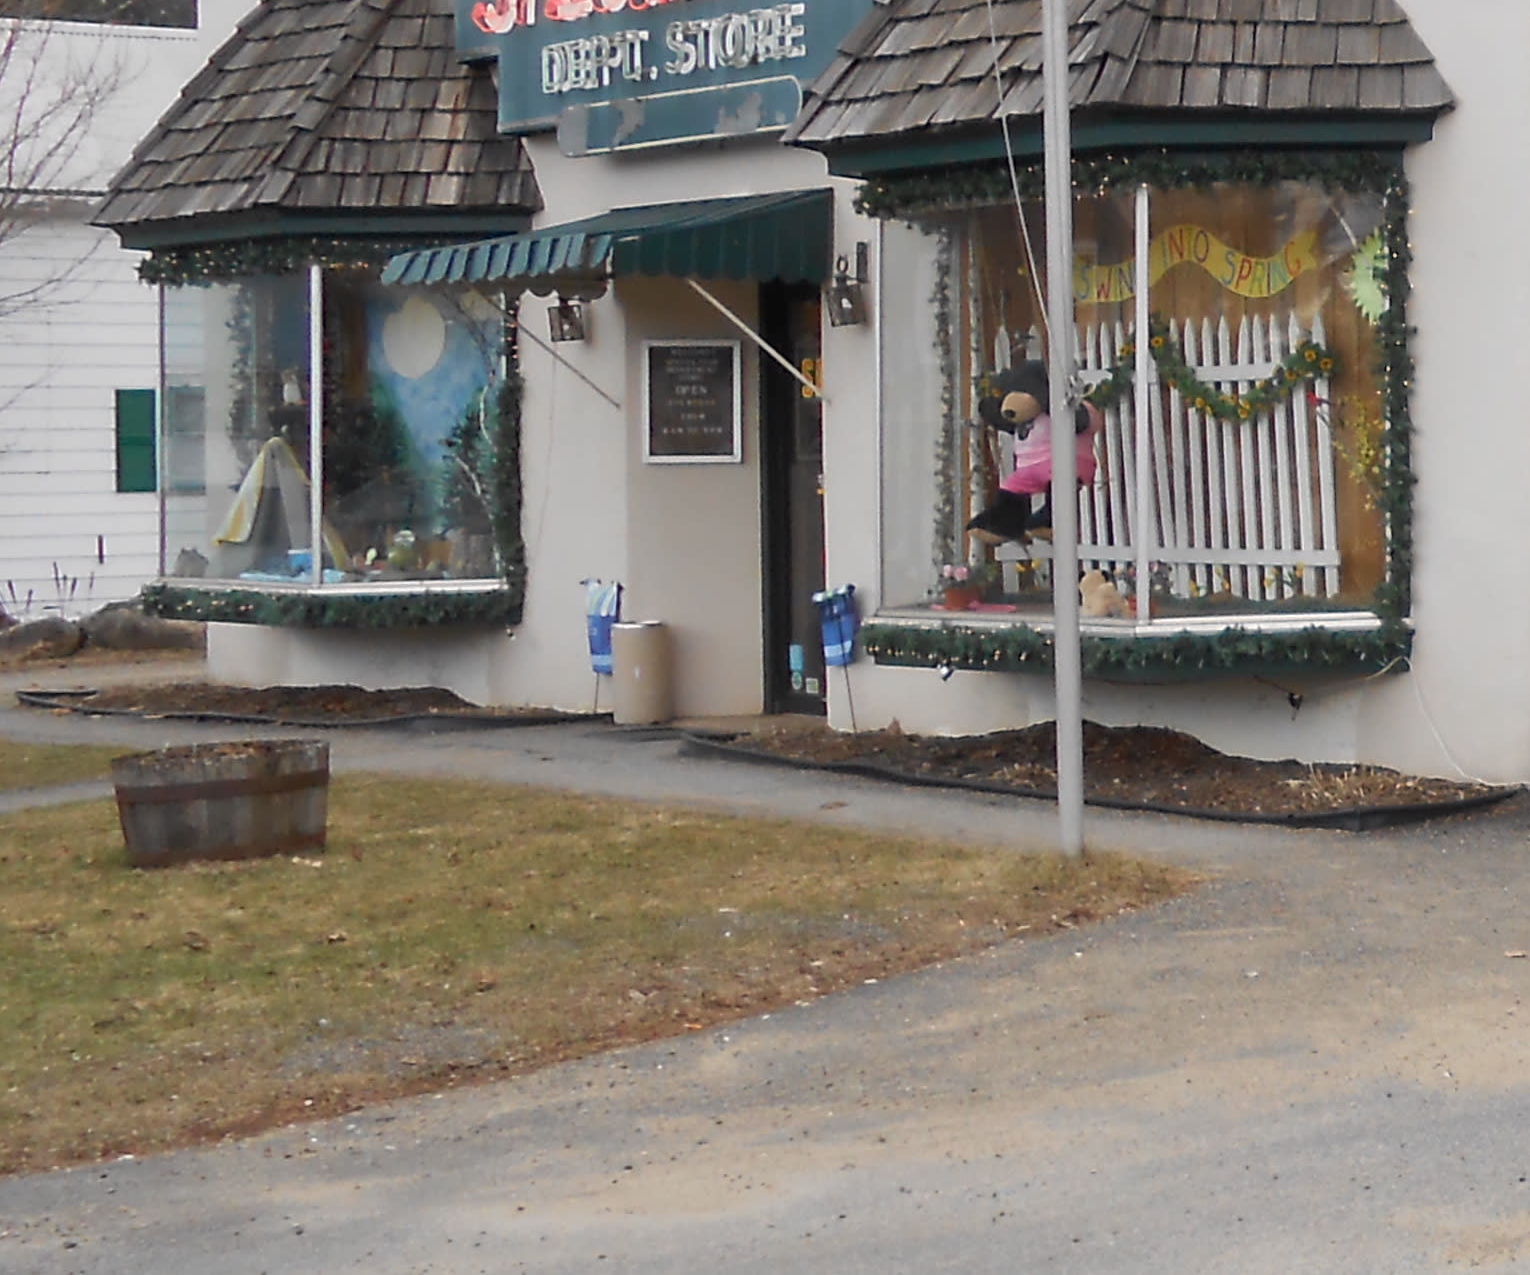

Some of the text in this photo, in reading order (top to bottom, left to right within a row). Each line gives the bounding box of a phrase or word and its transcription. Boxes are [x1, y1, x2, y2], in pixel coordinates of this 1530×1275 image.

[541, 2, 807, 94] DEPT. STORE
[1074, 227, 1302, 300] SWIN INTO SPRING
